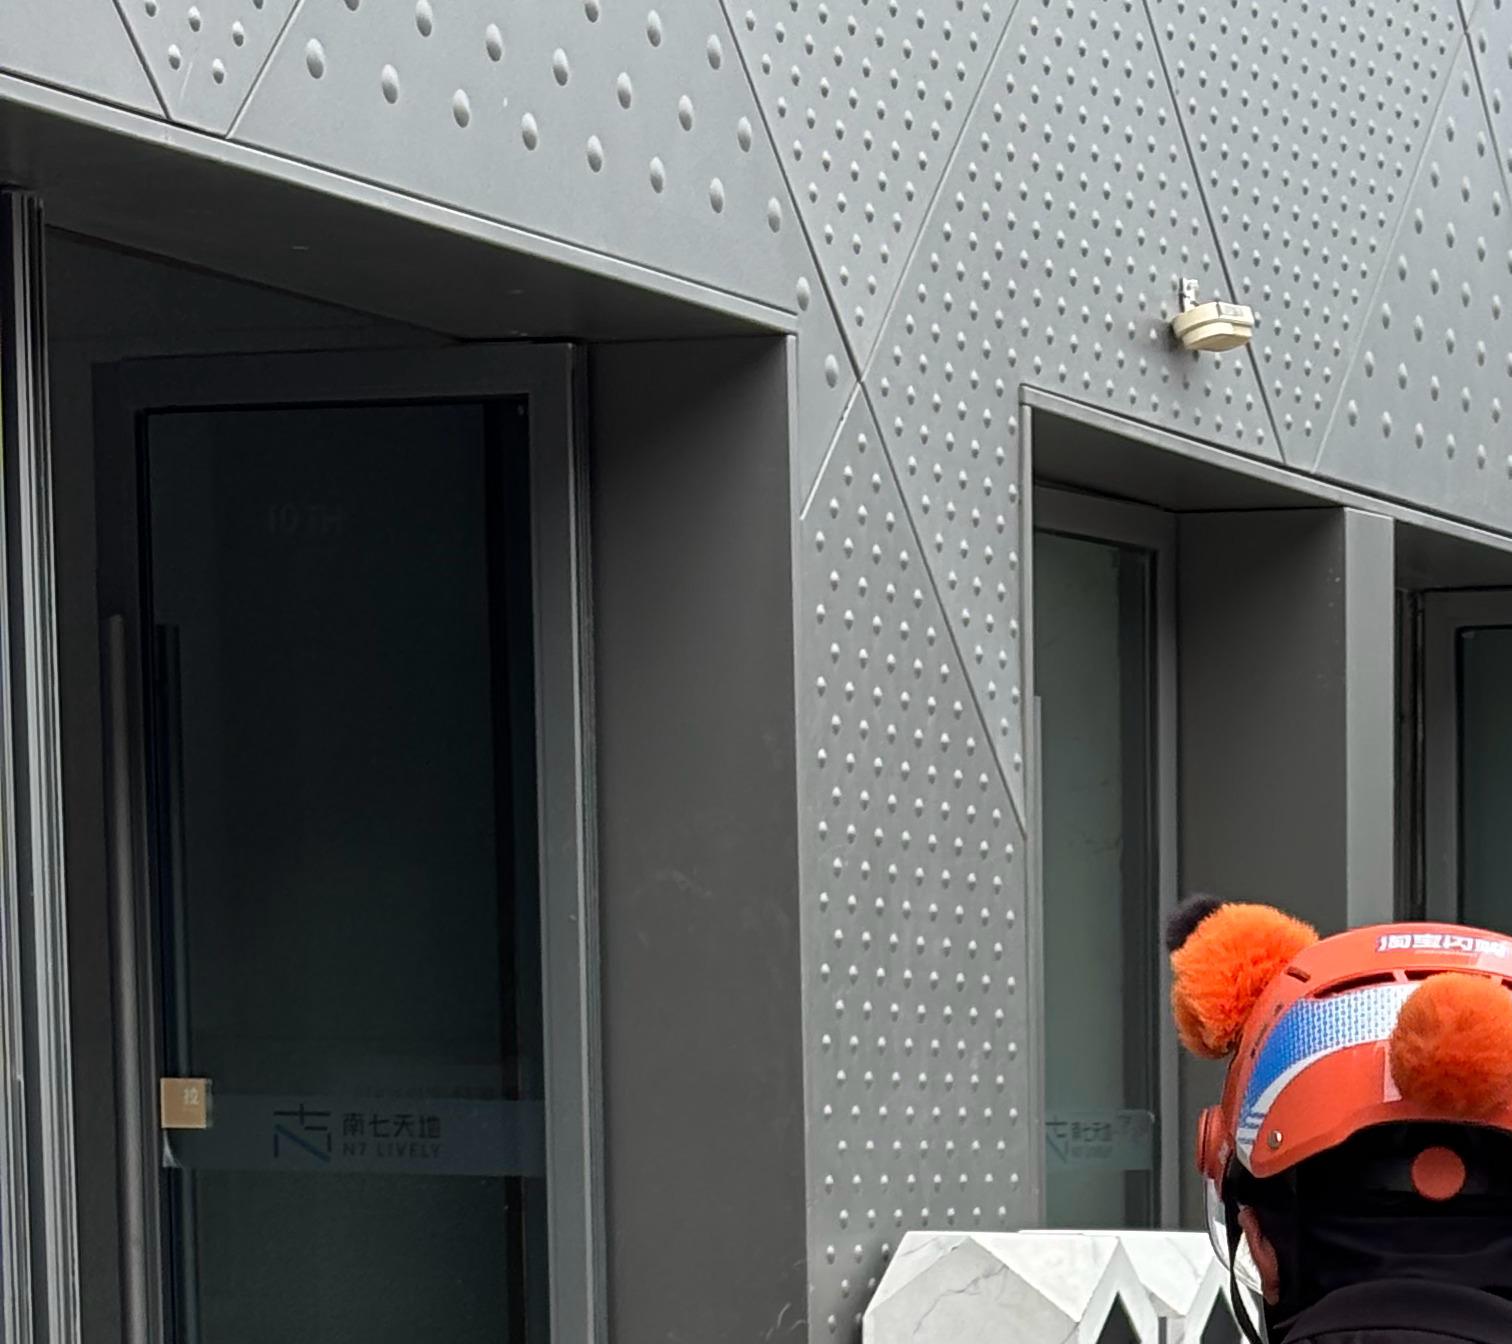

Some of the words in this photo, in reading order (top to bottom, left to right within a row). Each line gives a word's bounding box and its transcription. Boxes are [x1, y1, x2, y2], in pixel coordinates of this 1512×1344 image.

[342, 1113, 441, 1138] 南七天地
[342, 1142, 368, 1157] N7
[376, 1142, 442, 1158] LIVELY
